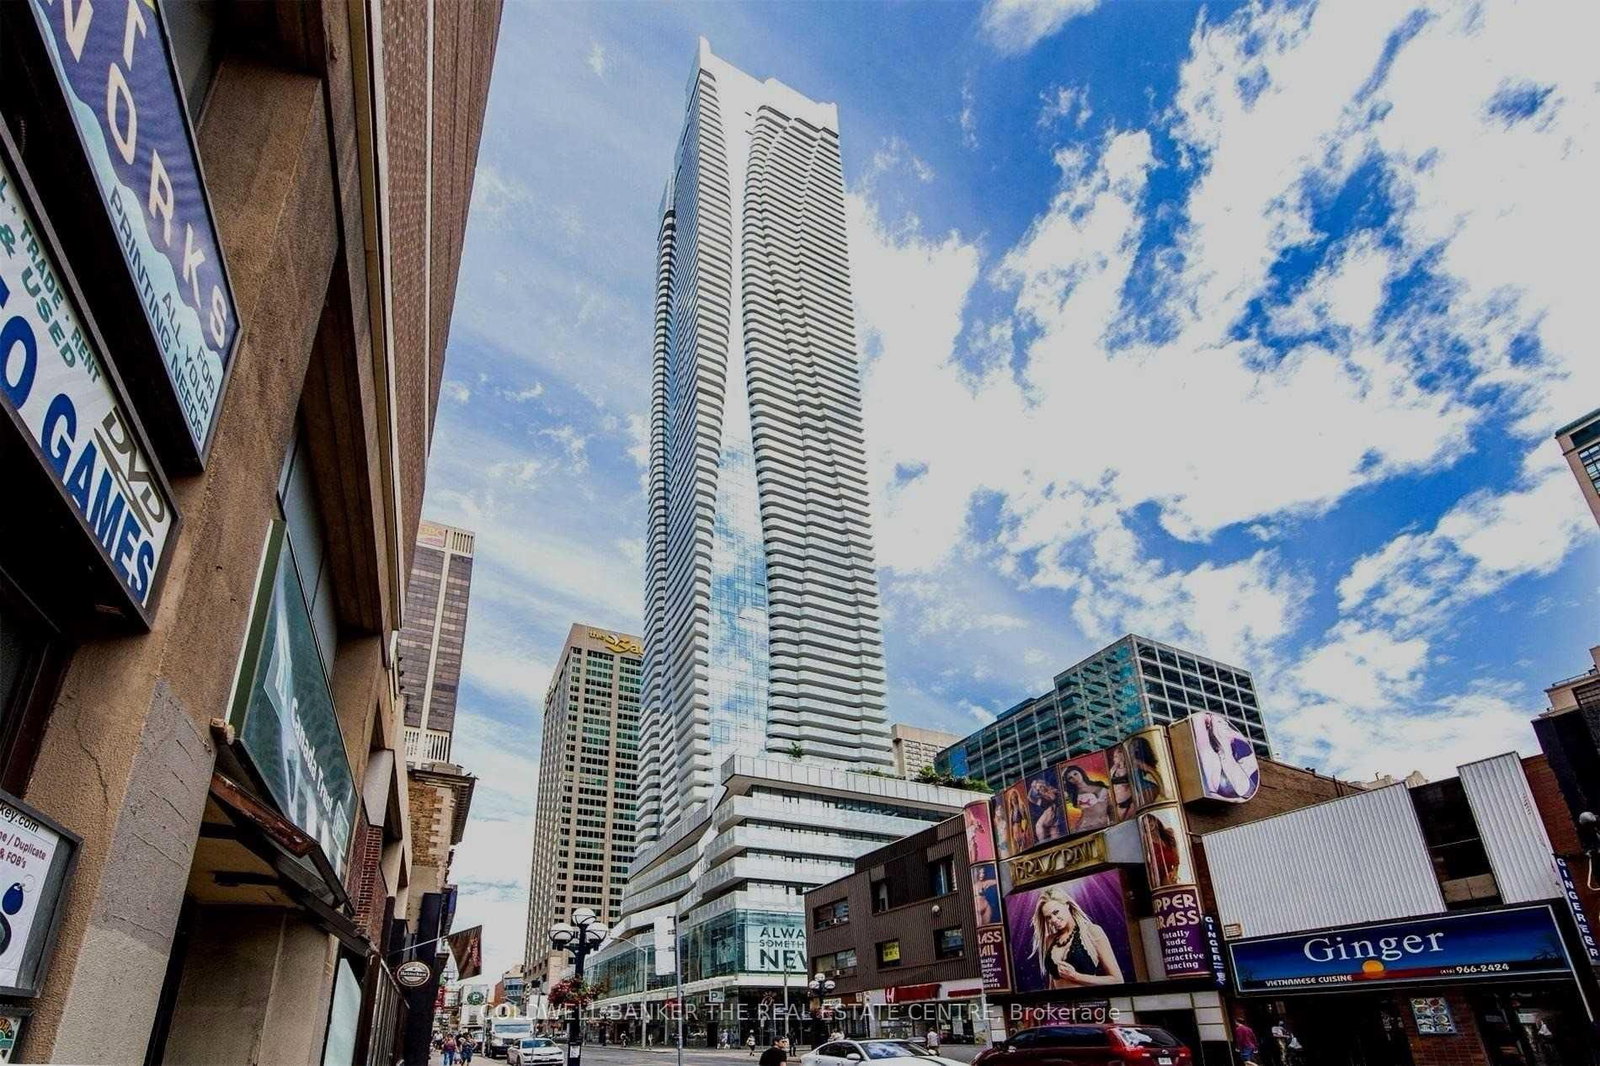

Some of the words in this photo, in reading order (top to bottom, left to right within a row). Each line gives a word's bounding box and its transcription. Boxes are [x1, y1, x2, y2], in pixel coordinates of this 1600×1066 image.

[20, 219, 64, 310] TRADE
[70, 325, 101, 384] RENT
[21, 266, 76, 368] USED
[110, 185, 171, 355] PRINTING
[171, 354, 204, 443] NEEDS
[162, 291, 182, 349] ALL
[185, 346, 209, 421] YOUR
[198, 345, 214, 401] FOR
[0, 276, 37, 410] O
[41, 393, 154, 606] GAMES
[102, 404, 166, 524] DVD
[291, 697, 318, 781] Canada
[317, 765, 334, 819] Trust
[6, 851, 27, 869] FOB's
[14, 836, 47, 861] Duplicate
[1153, 893, 1196, 912] PPER
[1265, 976, 1317, 987] VIETNAMESE
[1318, 974, 1353, 984] CUISINE
[1303, 932, 1445, 962] Ginger
[1456, 963, 1510, 974] 966-2424
